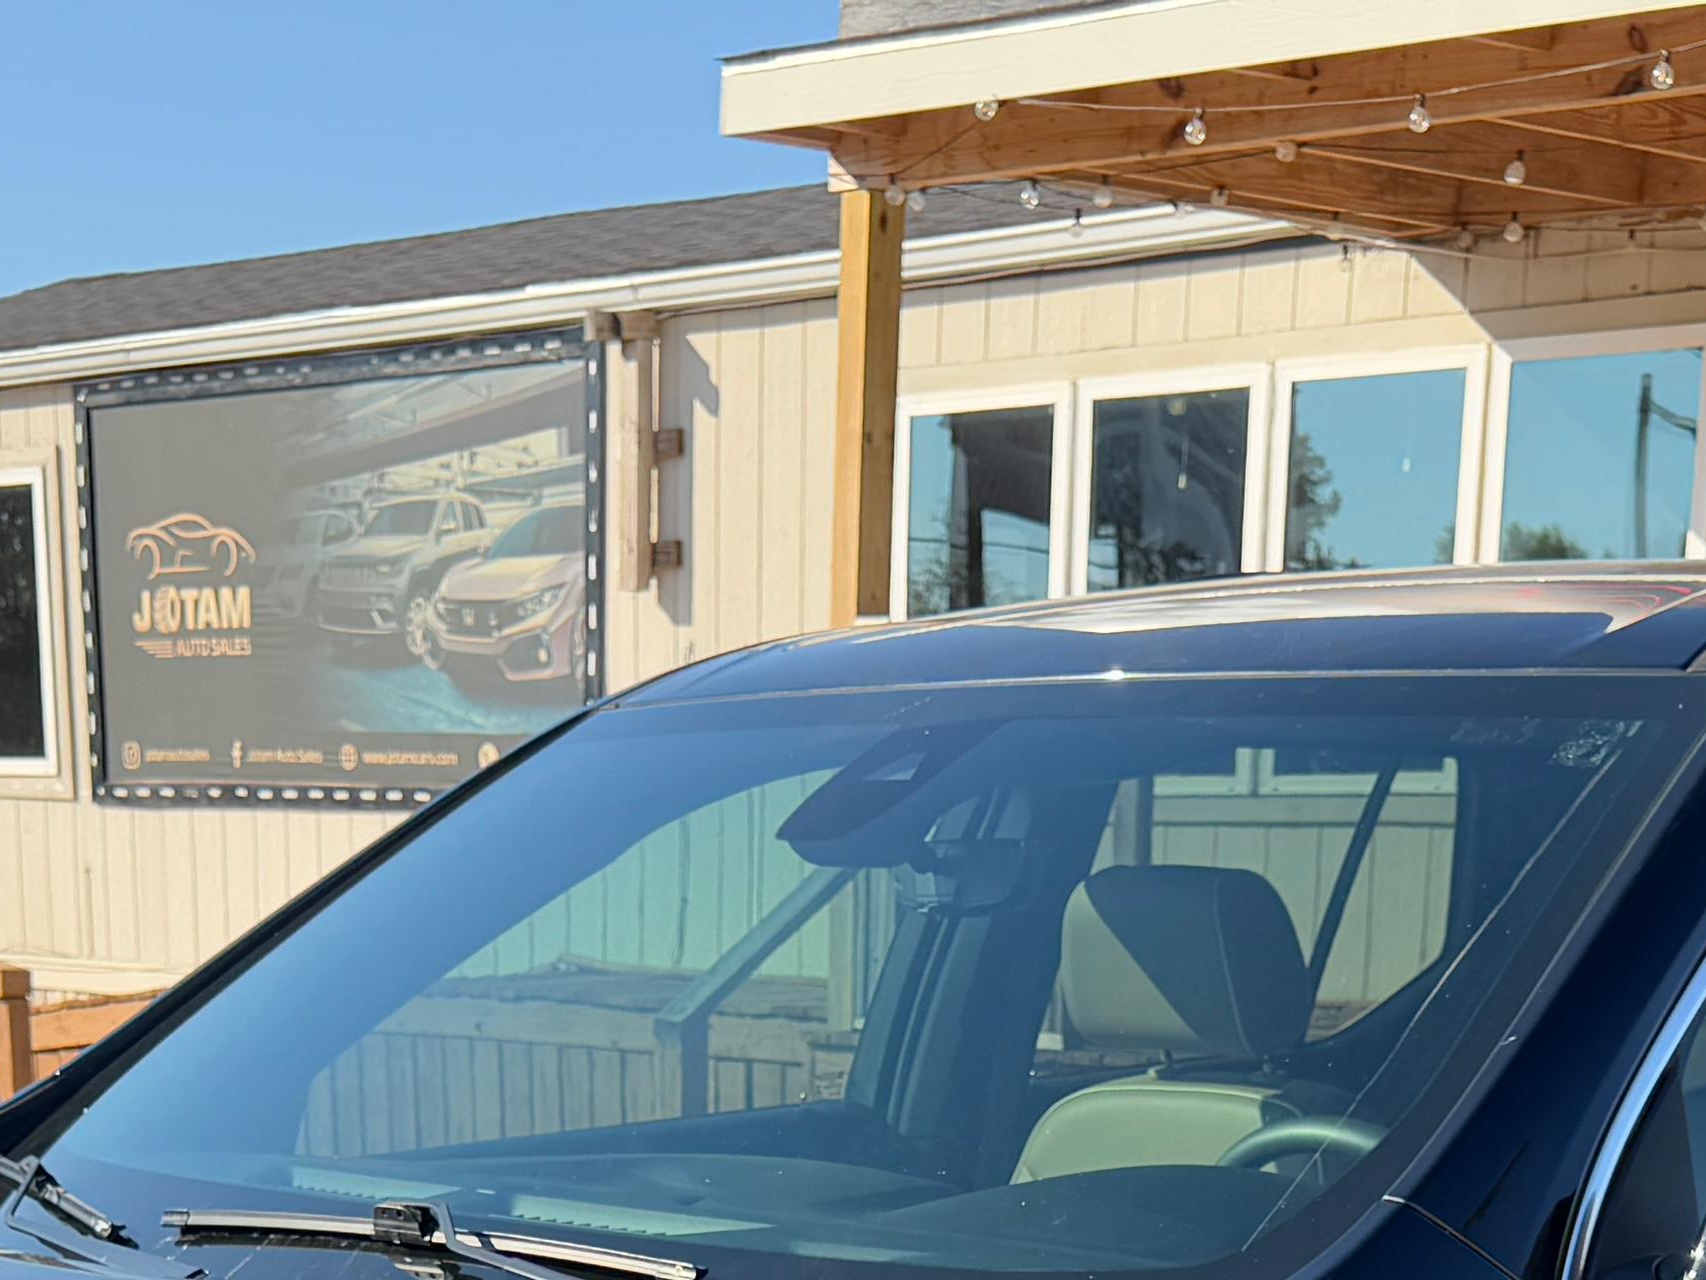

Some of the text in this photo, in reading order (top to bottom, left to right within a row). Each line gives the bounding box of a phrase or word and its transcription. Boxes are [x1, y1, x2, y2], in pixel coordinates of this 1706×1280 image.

[132, 585, 251, 634] JOTAM
[176, 635, 252, 657] AUTO SALES
